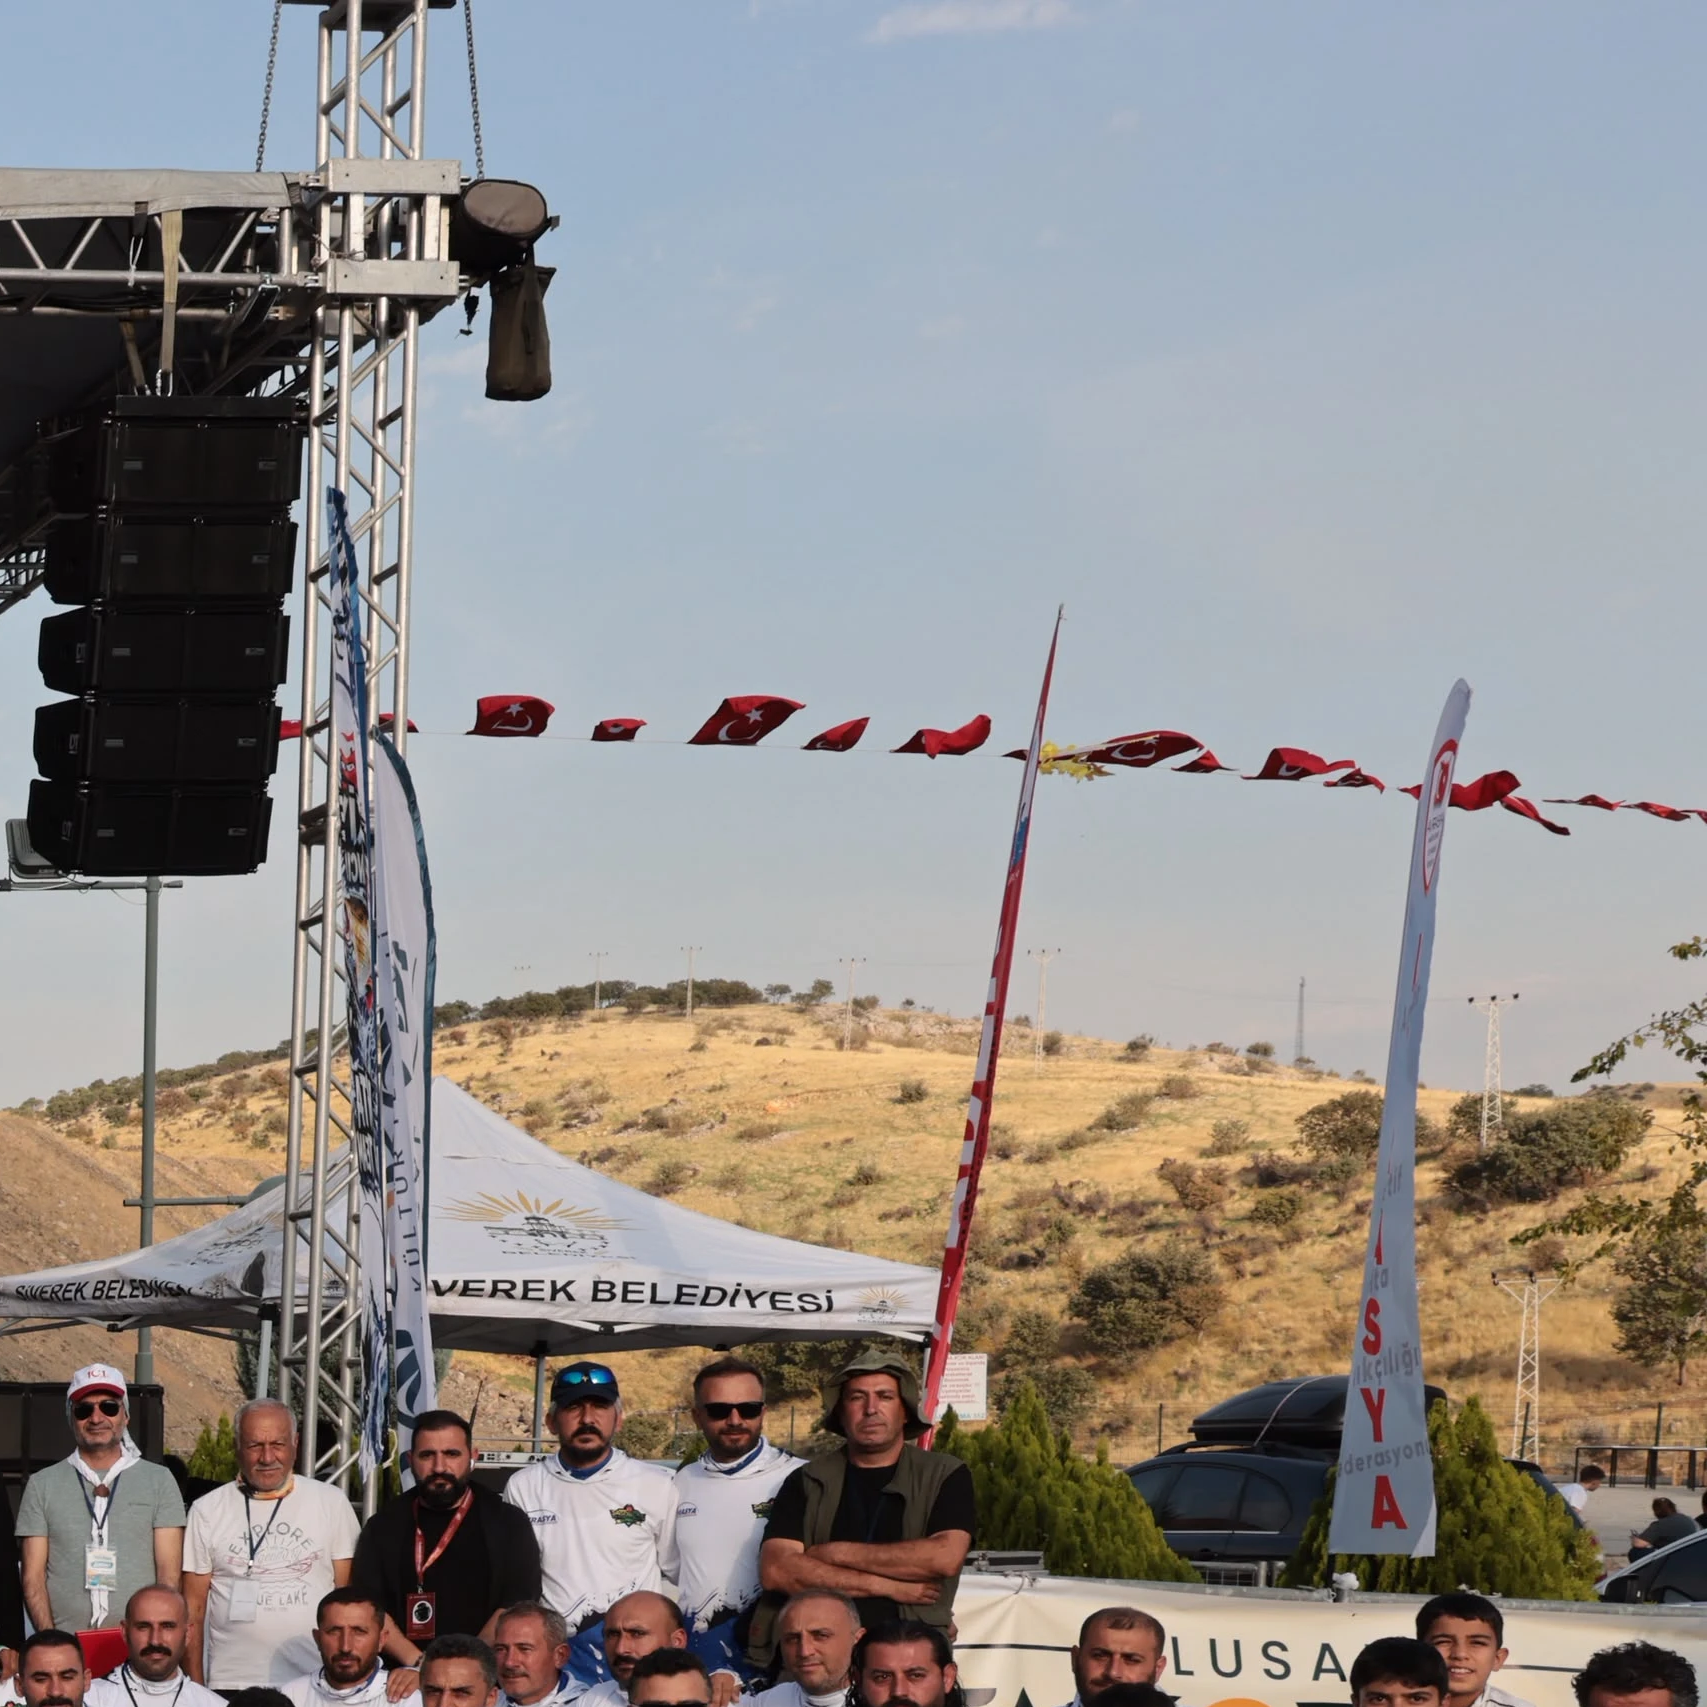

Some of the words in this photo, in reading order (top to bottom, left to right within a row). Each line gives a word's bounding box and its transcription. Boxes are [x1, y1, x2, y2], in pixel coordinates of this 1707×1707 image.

[14, 1280, 87, 1302] SİVEREK
[429, 1278, 576, 1302] VEREK
[590, 1279, 835, 1313] BELEDİYESİ
[228, 1522, 315, 1556] EXPLORE
[278, 1589, 309, 1606] LAKE
[1171, 1638, 1350, 1684] LUSA
